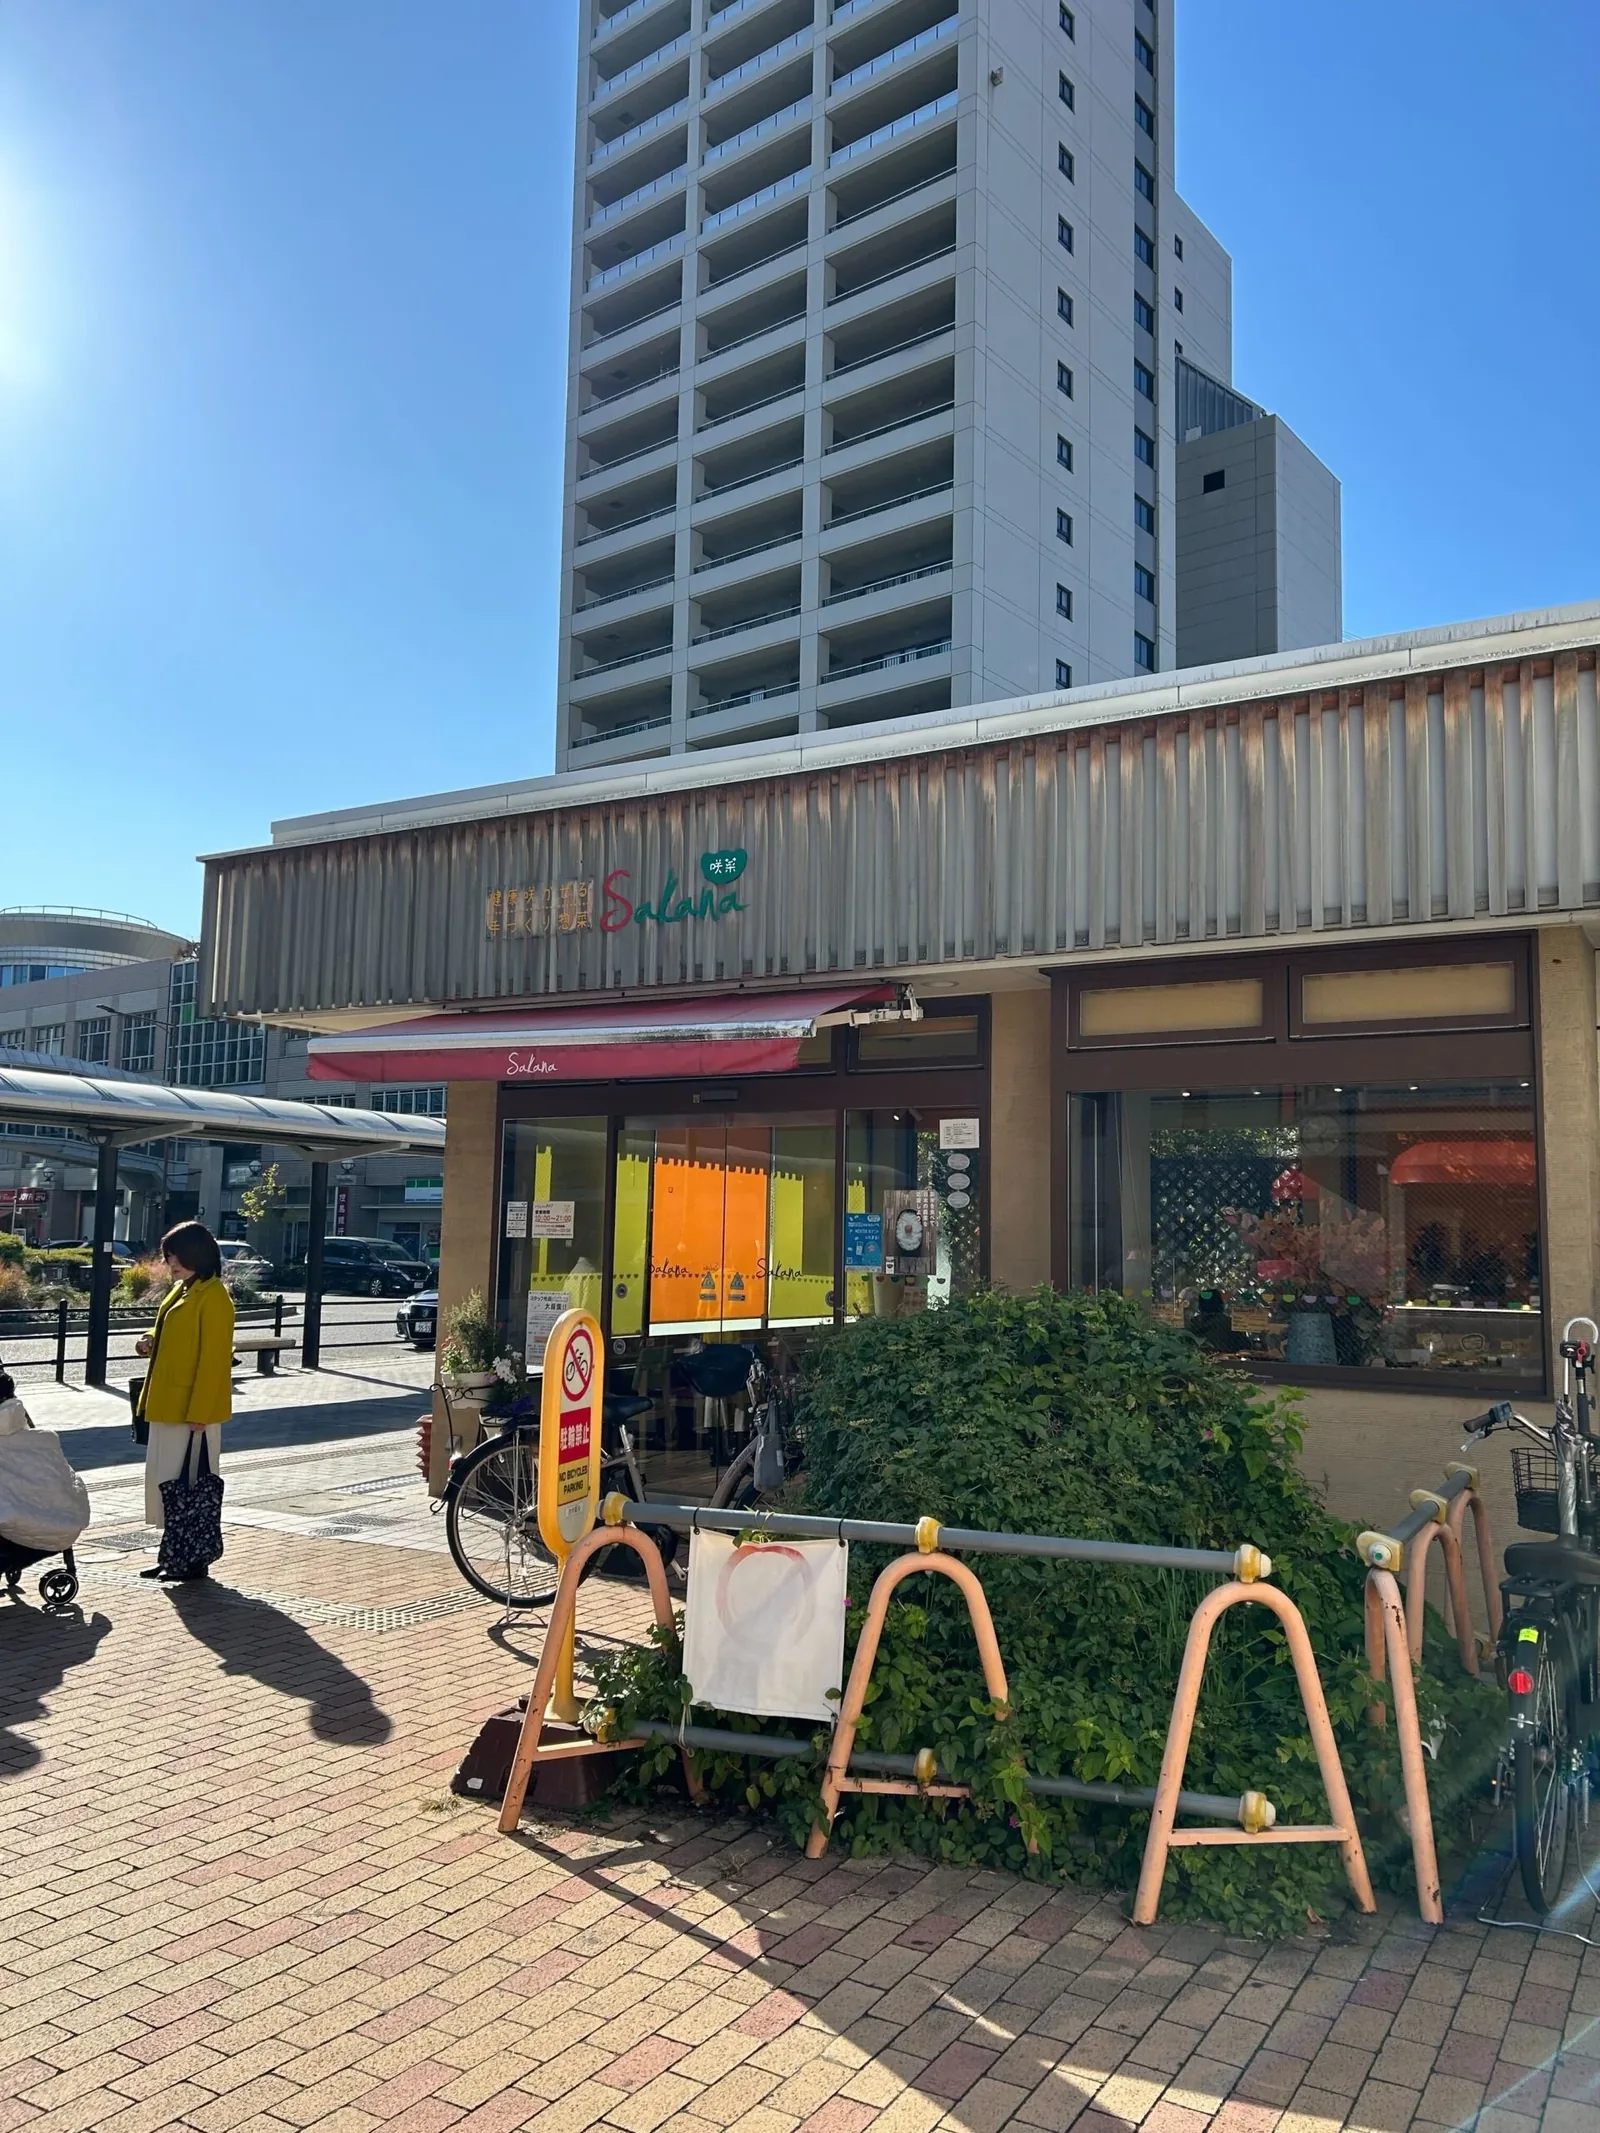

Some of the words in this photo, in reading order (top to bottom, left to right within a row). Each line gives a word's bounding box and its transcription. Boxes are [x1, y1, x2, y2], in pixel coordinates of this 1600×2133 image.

[709, 858, 737, 874] 咲菜
[600, 869, 750, 932] Sakana
[506, 1051, 559, 1076] Sakana
[756, 1257, 804, 1279] Sakana
[560, 1422, 589, 1450] 駐輪禁止
[559, 1473, 566, 1481] NO
[567, 1466, 588, 1479] BICYCLES
[564, 1480, 583, 1494] PARKING
